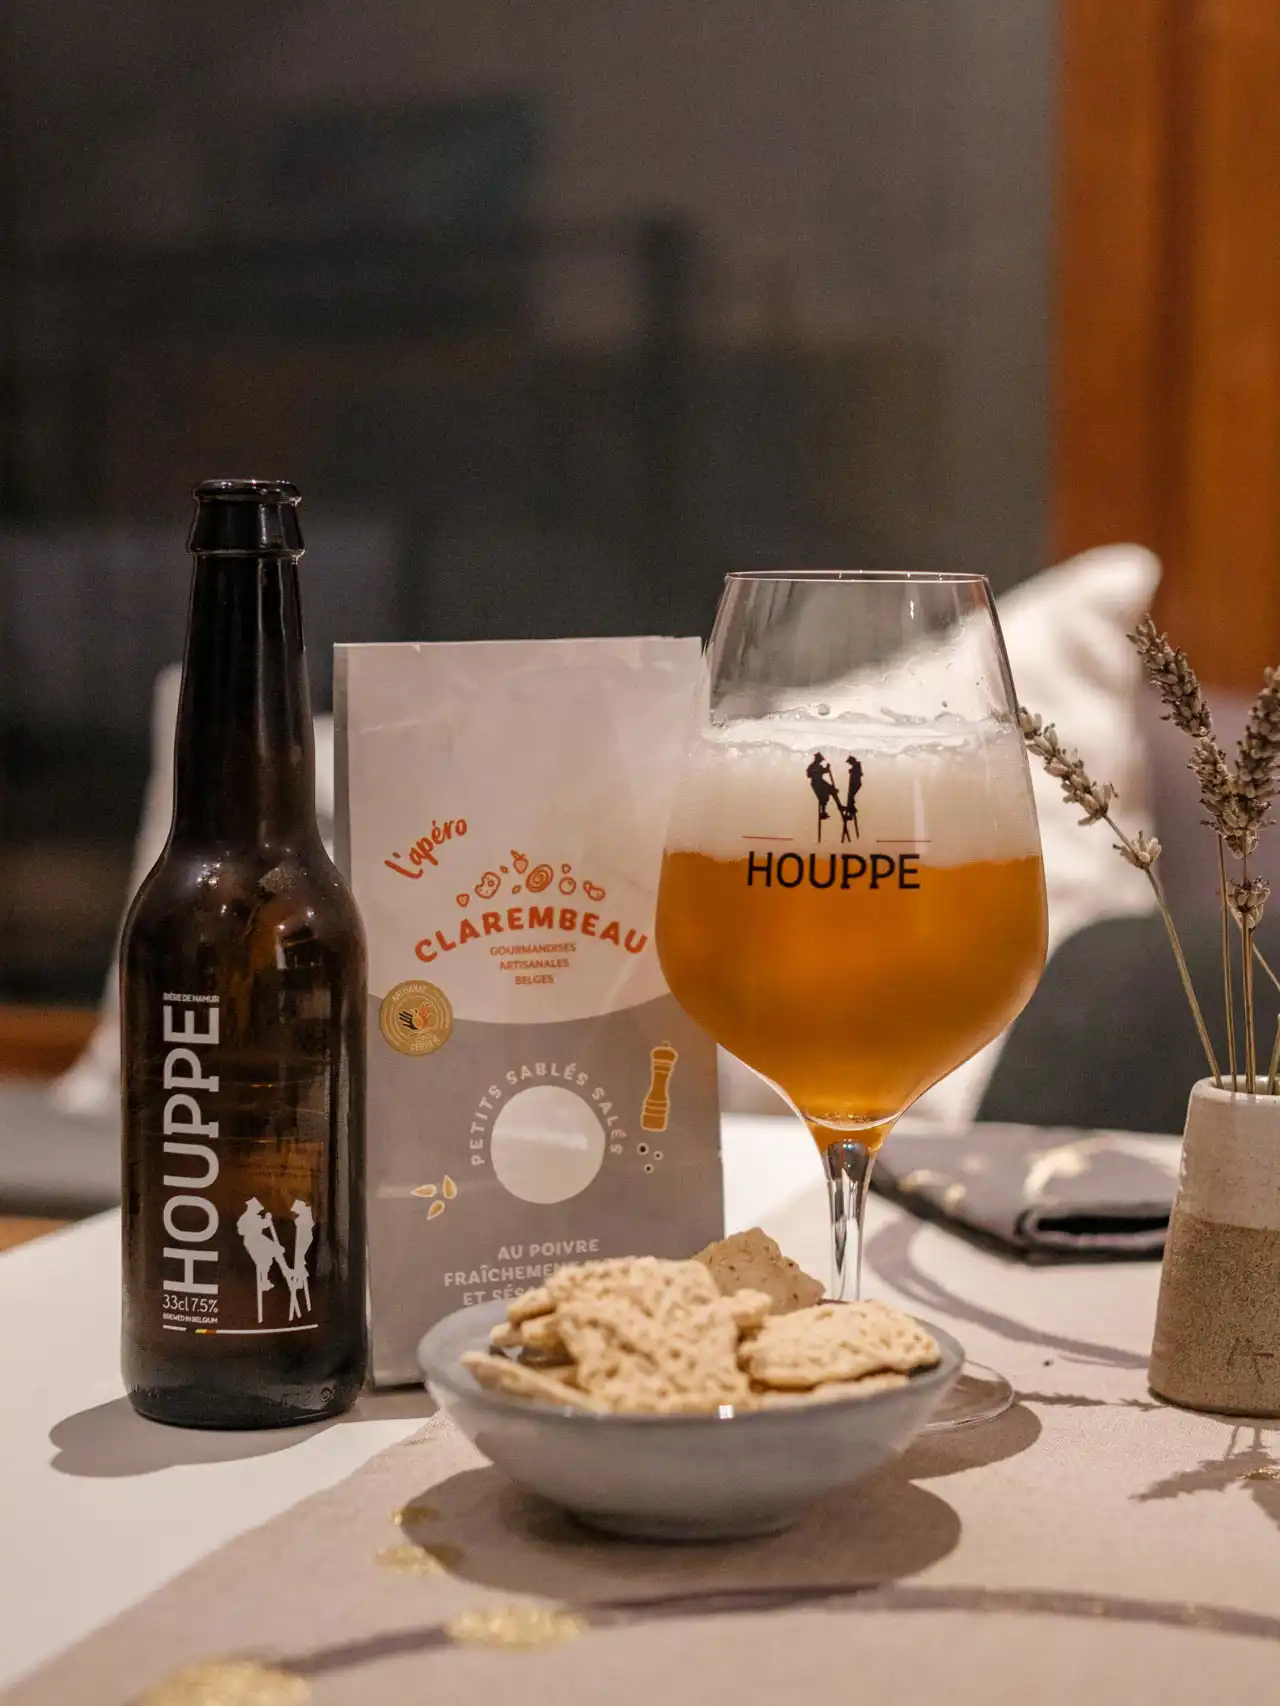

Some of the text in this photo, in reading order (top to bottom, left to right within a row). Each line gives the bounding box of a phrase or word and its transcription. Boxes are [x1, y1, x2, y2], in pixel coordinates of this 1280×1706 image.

[747, 850, 921, 890] HOUPPE
[414, 906, 649, 964] CLAREMBEAU
[489, 942, 577, 957] GOURMANDISES
[499, 958, 570, 971] ARTISANALES
[515, 974, 555, 986] BELGES
[469, 1061, 628, 1167] PETITS SABLÉS SALÉS
[162, 1004, 220, 1295] HOUPPE
[497, 1238, 600, 1261] AU POIVRE
[443, 1261, 580, 1287] FRAÎCHEME
[162, 1294, 218, 1313] 33cl 7.5%
[463, 1290, 487, 1306] ET
[163, 1312, 185, 1321] BREWED
[191, 1315, 218, 1324] BELGIUM
